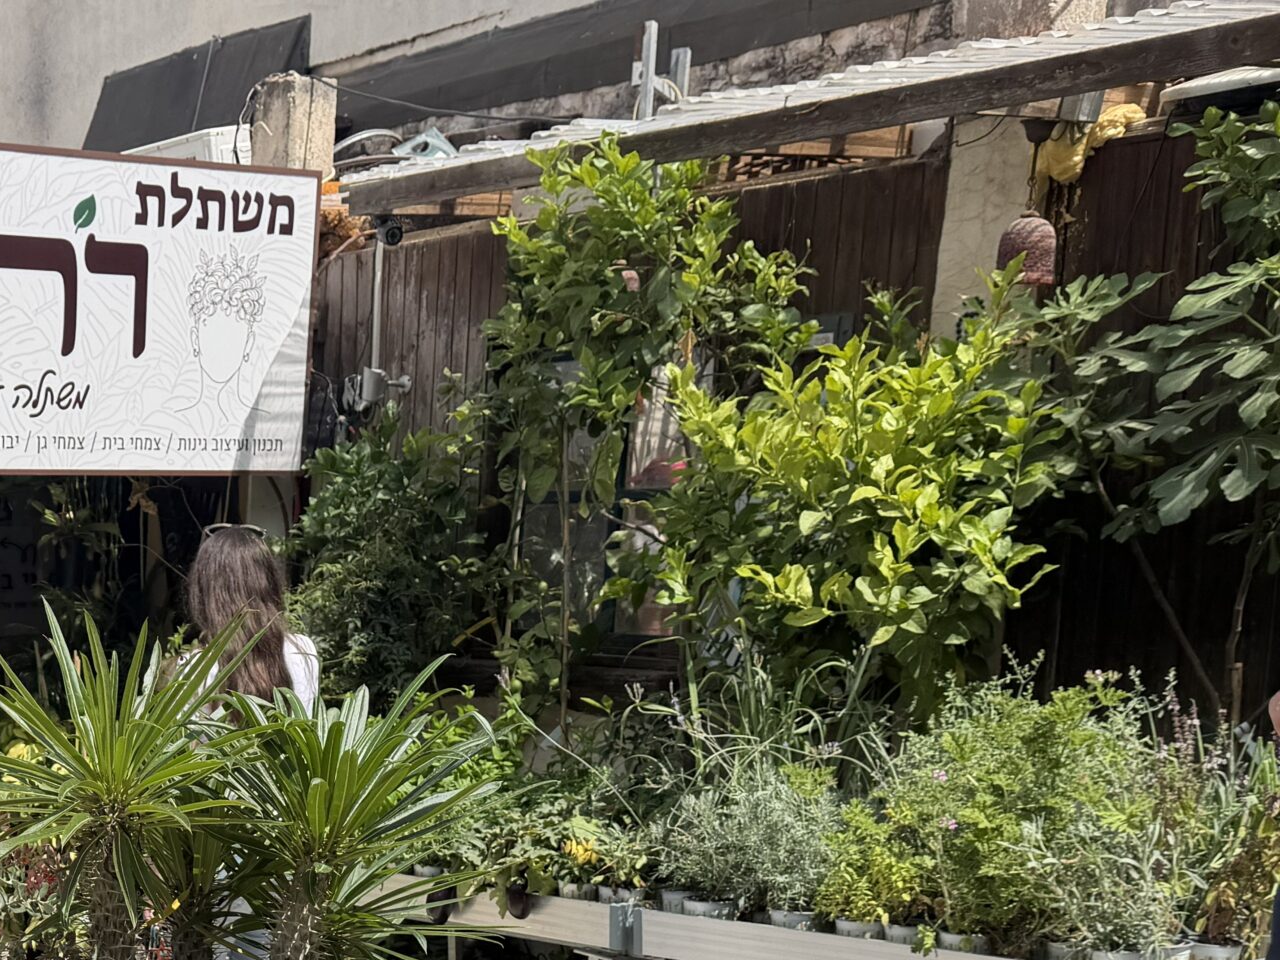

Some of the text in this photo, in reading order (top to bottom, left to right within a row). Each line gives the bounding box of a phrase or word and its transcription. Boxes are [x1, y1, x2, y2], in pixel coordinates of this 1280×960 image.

[134, 171, 296, 236] משתלת
[12, 369, 91, 418] משתלה
[37, 434, 48, 454] גן
[52, 434, 85, 451] צמחי
[102, 435, 125, 451] בית
[130, 435, 161, 451] צמחי
[177, 435, 208, 452] גינות
[212, 436, 250, 452] ועיצוב
[252, 437, 284, 456] תכנון
